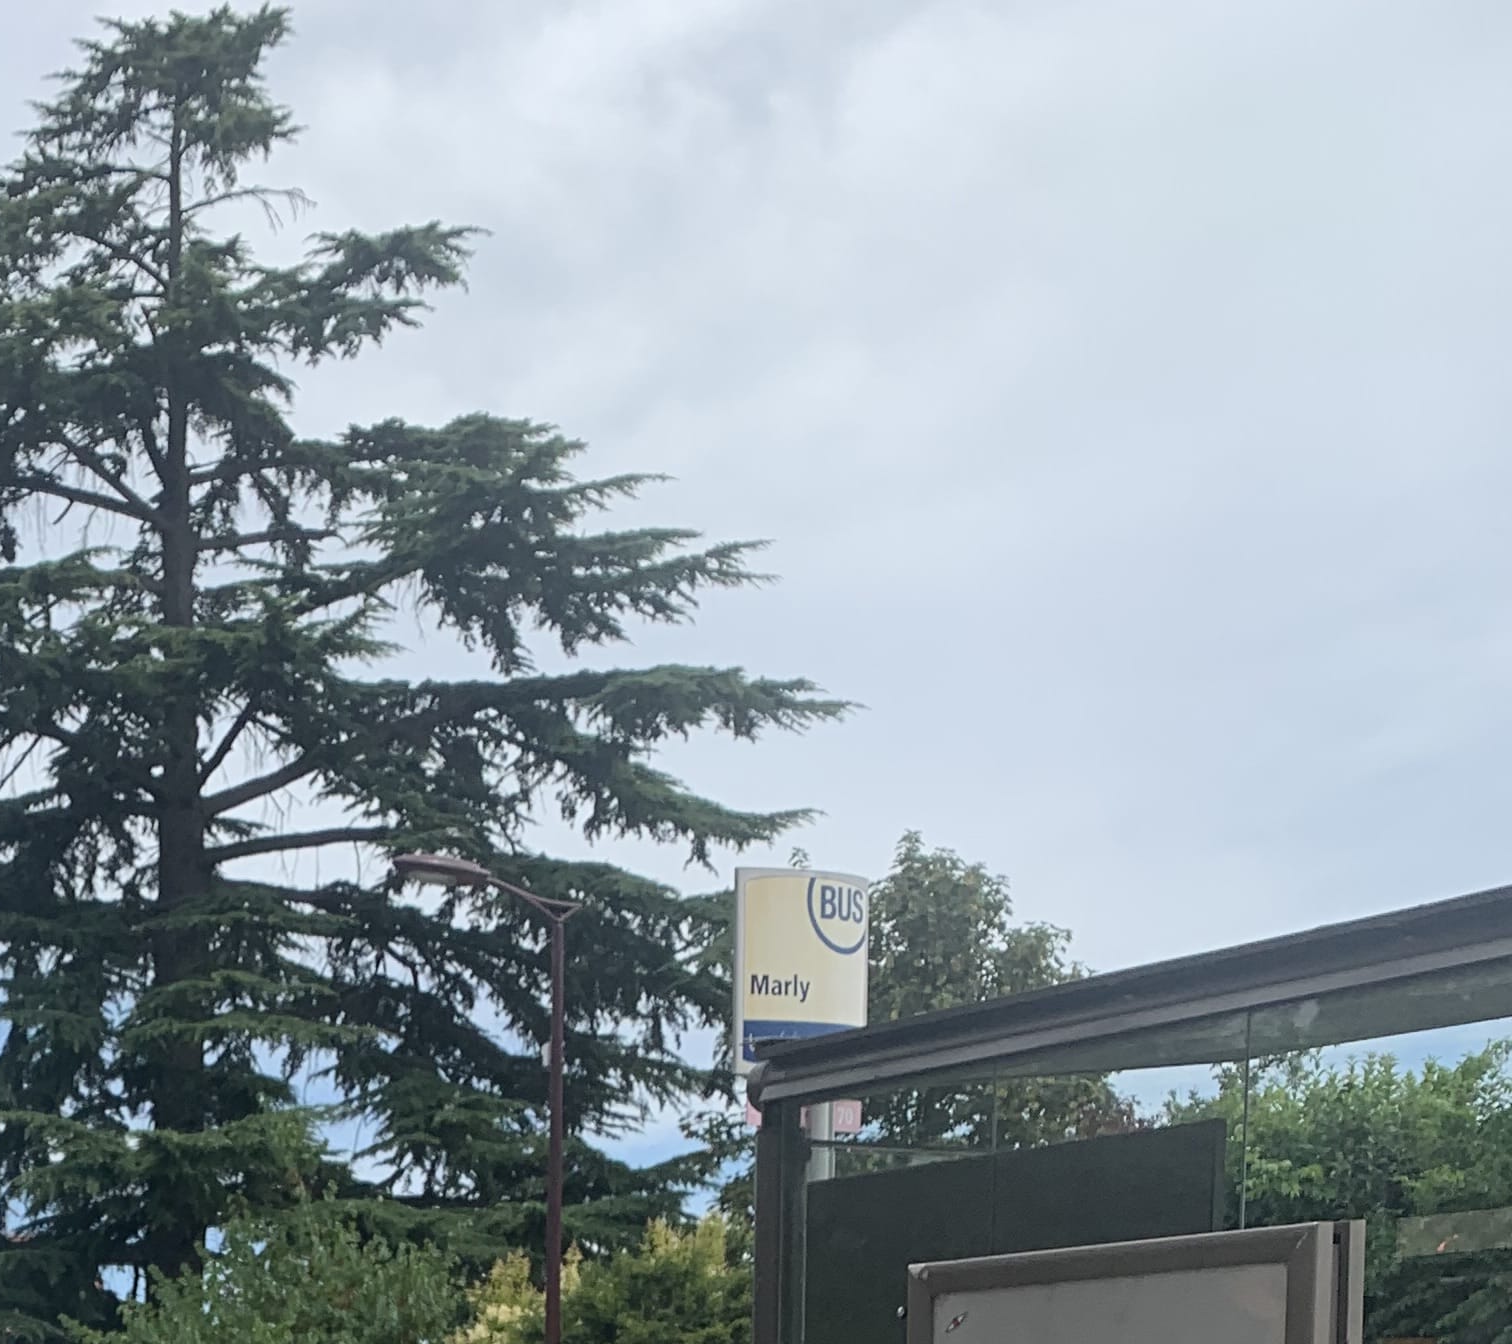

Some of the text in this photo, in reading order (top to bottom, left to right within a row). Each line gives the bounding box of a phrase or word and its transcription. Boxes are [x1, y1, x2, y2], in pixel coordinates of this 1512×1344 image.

[820, 885, 863, 924] BUS
[750, 974, 811, 1003] Marly
[837, 1105, 854, 1125] 70
